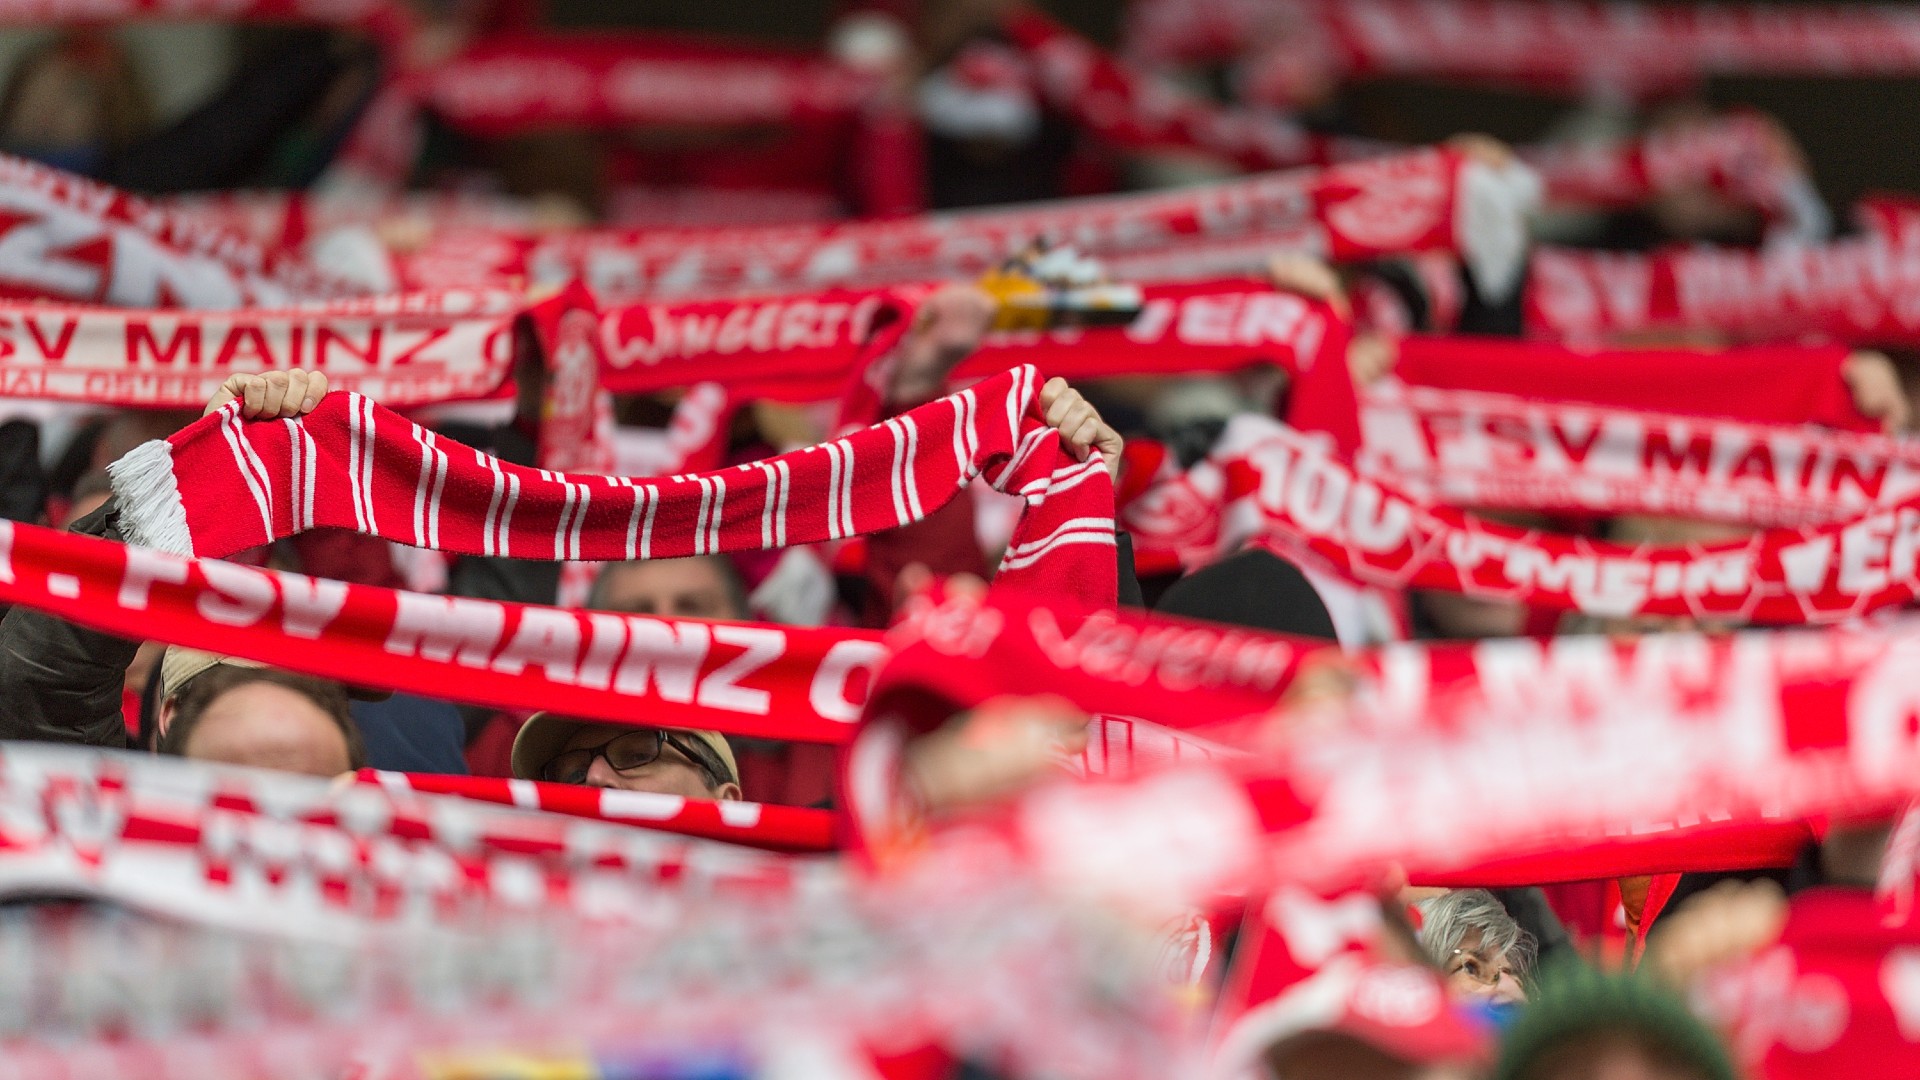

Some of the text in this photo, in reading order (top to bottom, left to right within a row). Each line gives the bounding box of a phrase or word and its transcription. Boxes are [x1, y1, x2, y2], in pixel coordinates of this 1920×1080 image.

[122, 320, 452, 373] MAINZ
[1643, 430, 1920, 501] MAIN
[117, 543, 350, 641] FSV
[384, 590, 787, 716] MAINZ
